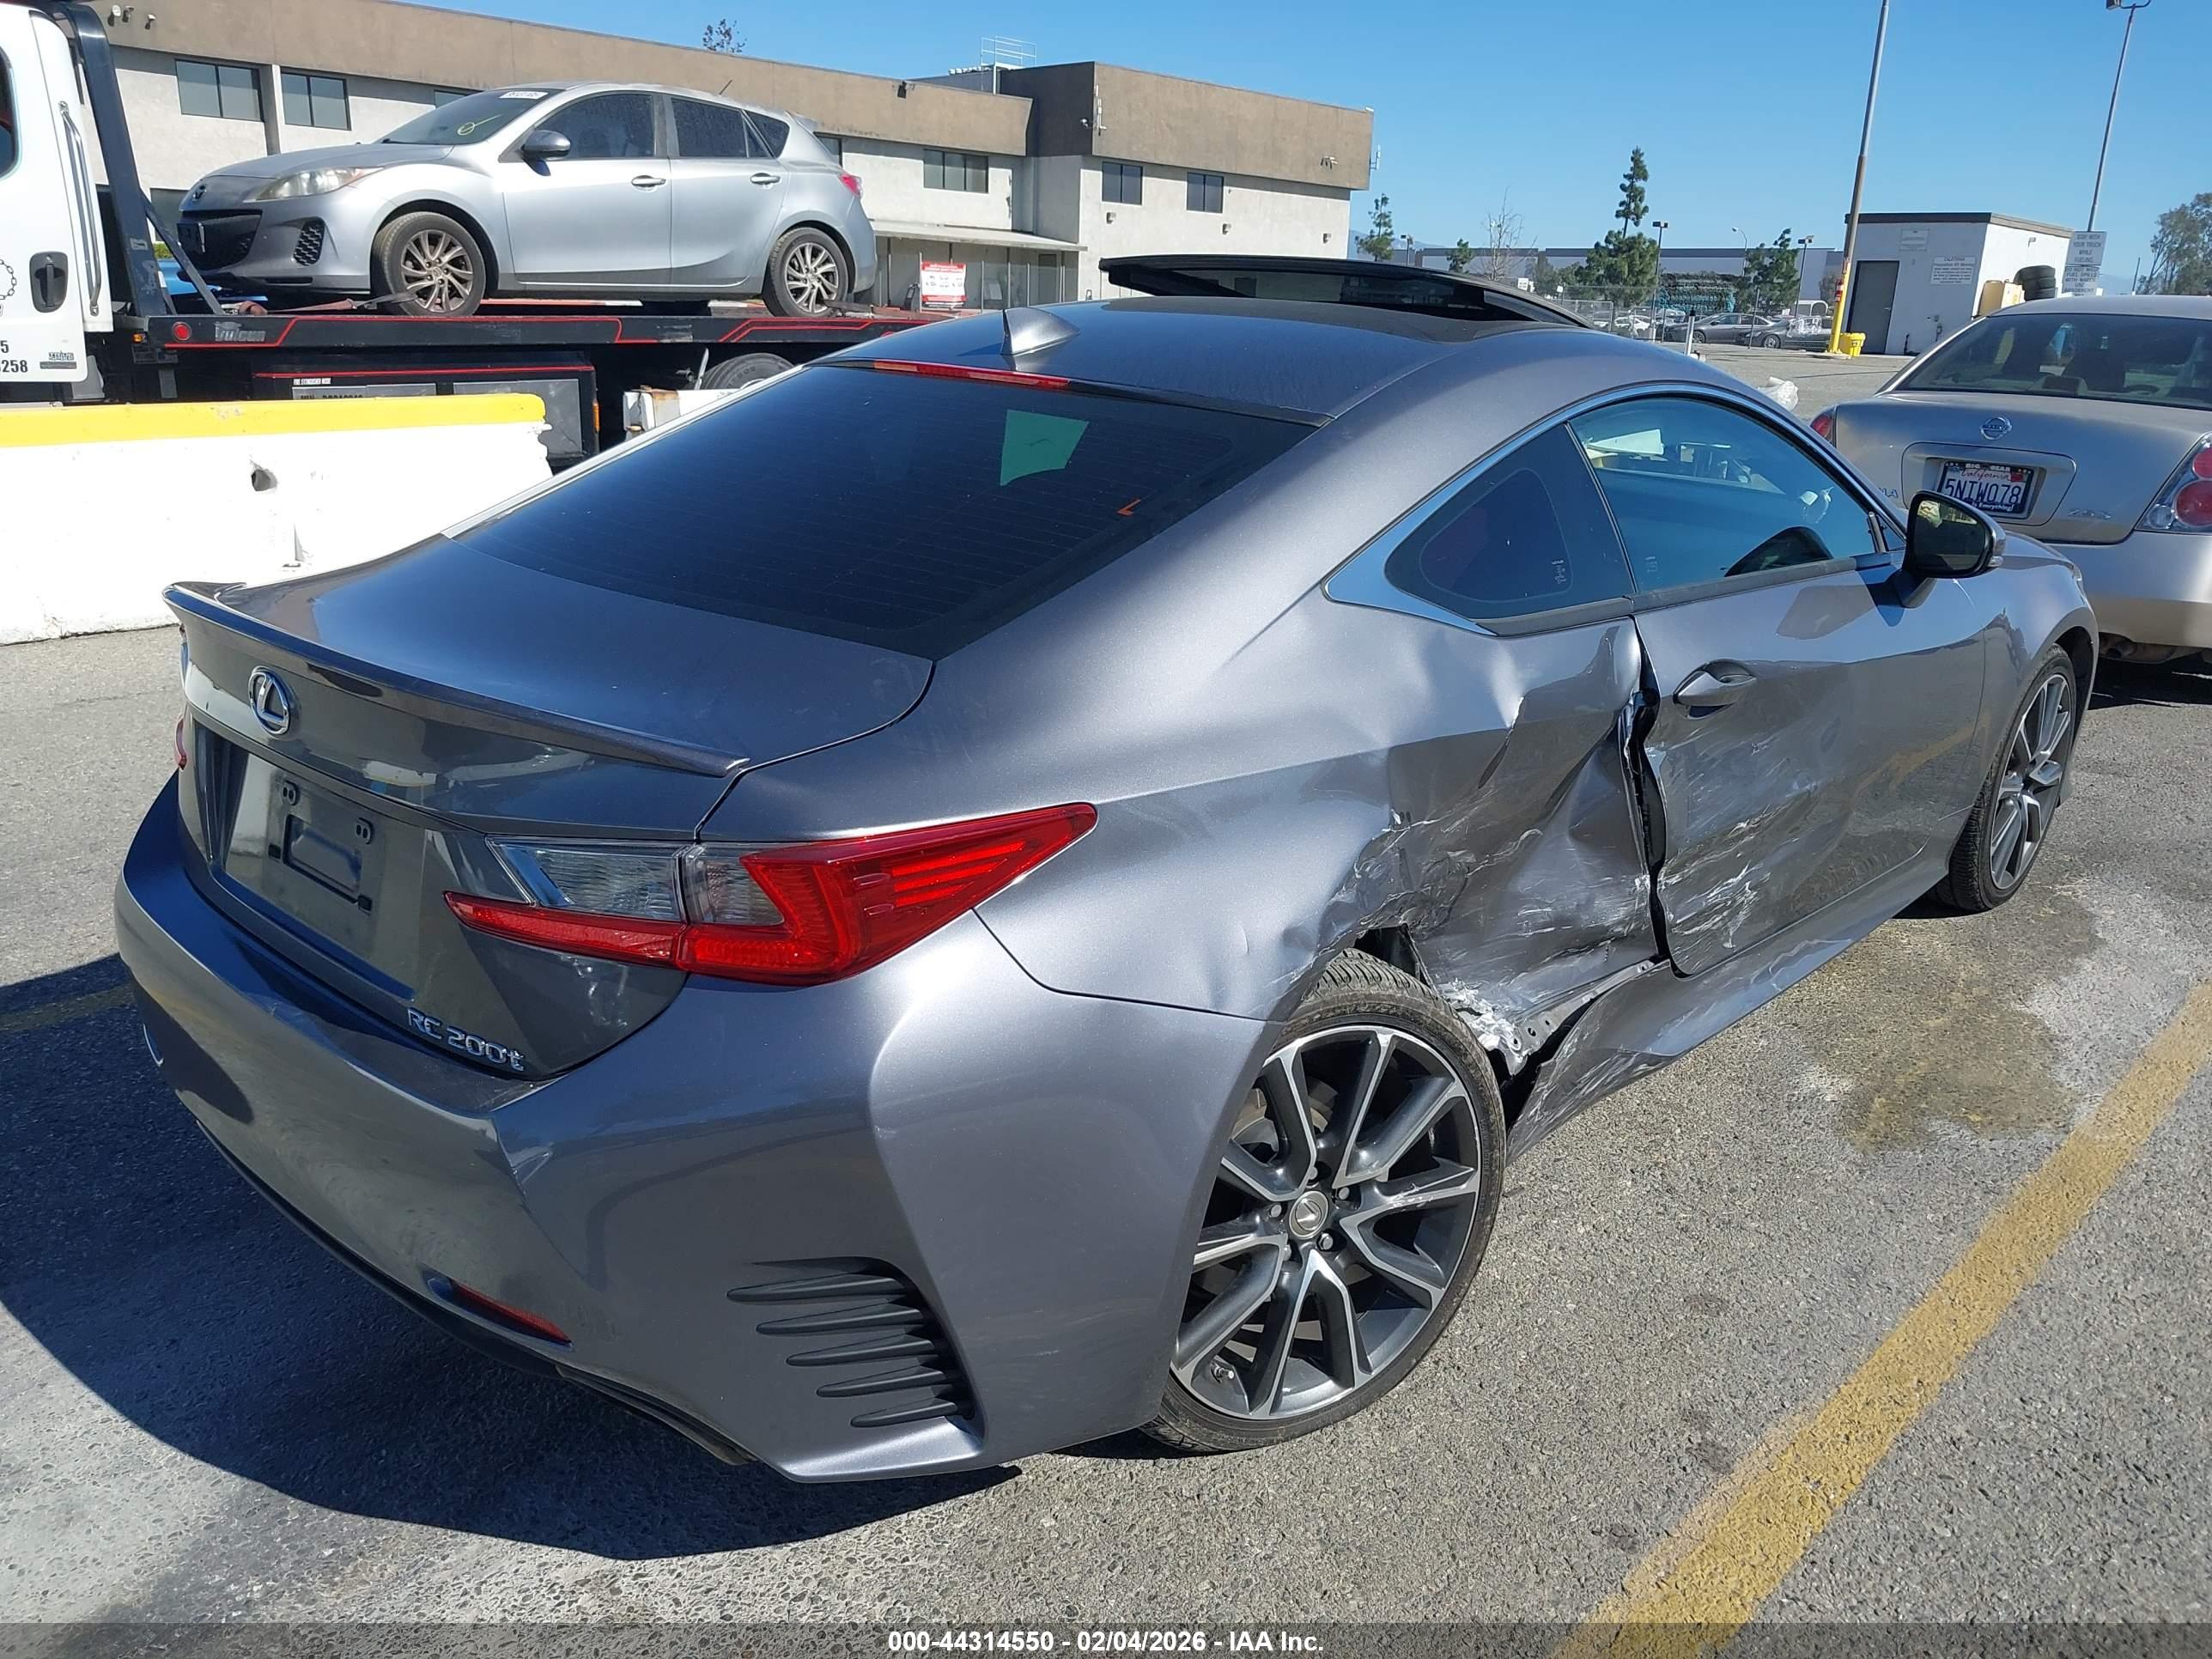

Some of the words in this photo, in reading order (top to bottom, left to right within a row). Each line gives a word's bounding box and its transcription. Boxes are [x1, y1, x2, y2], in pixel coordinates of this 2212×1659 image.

[0, 360, 28, 373] 258
[1960, 469, 2011, 481] California
[446, 1025, 525, 1072] 200t
